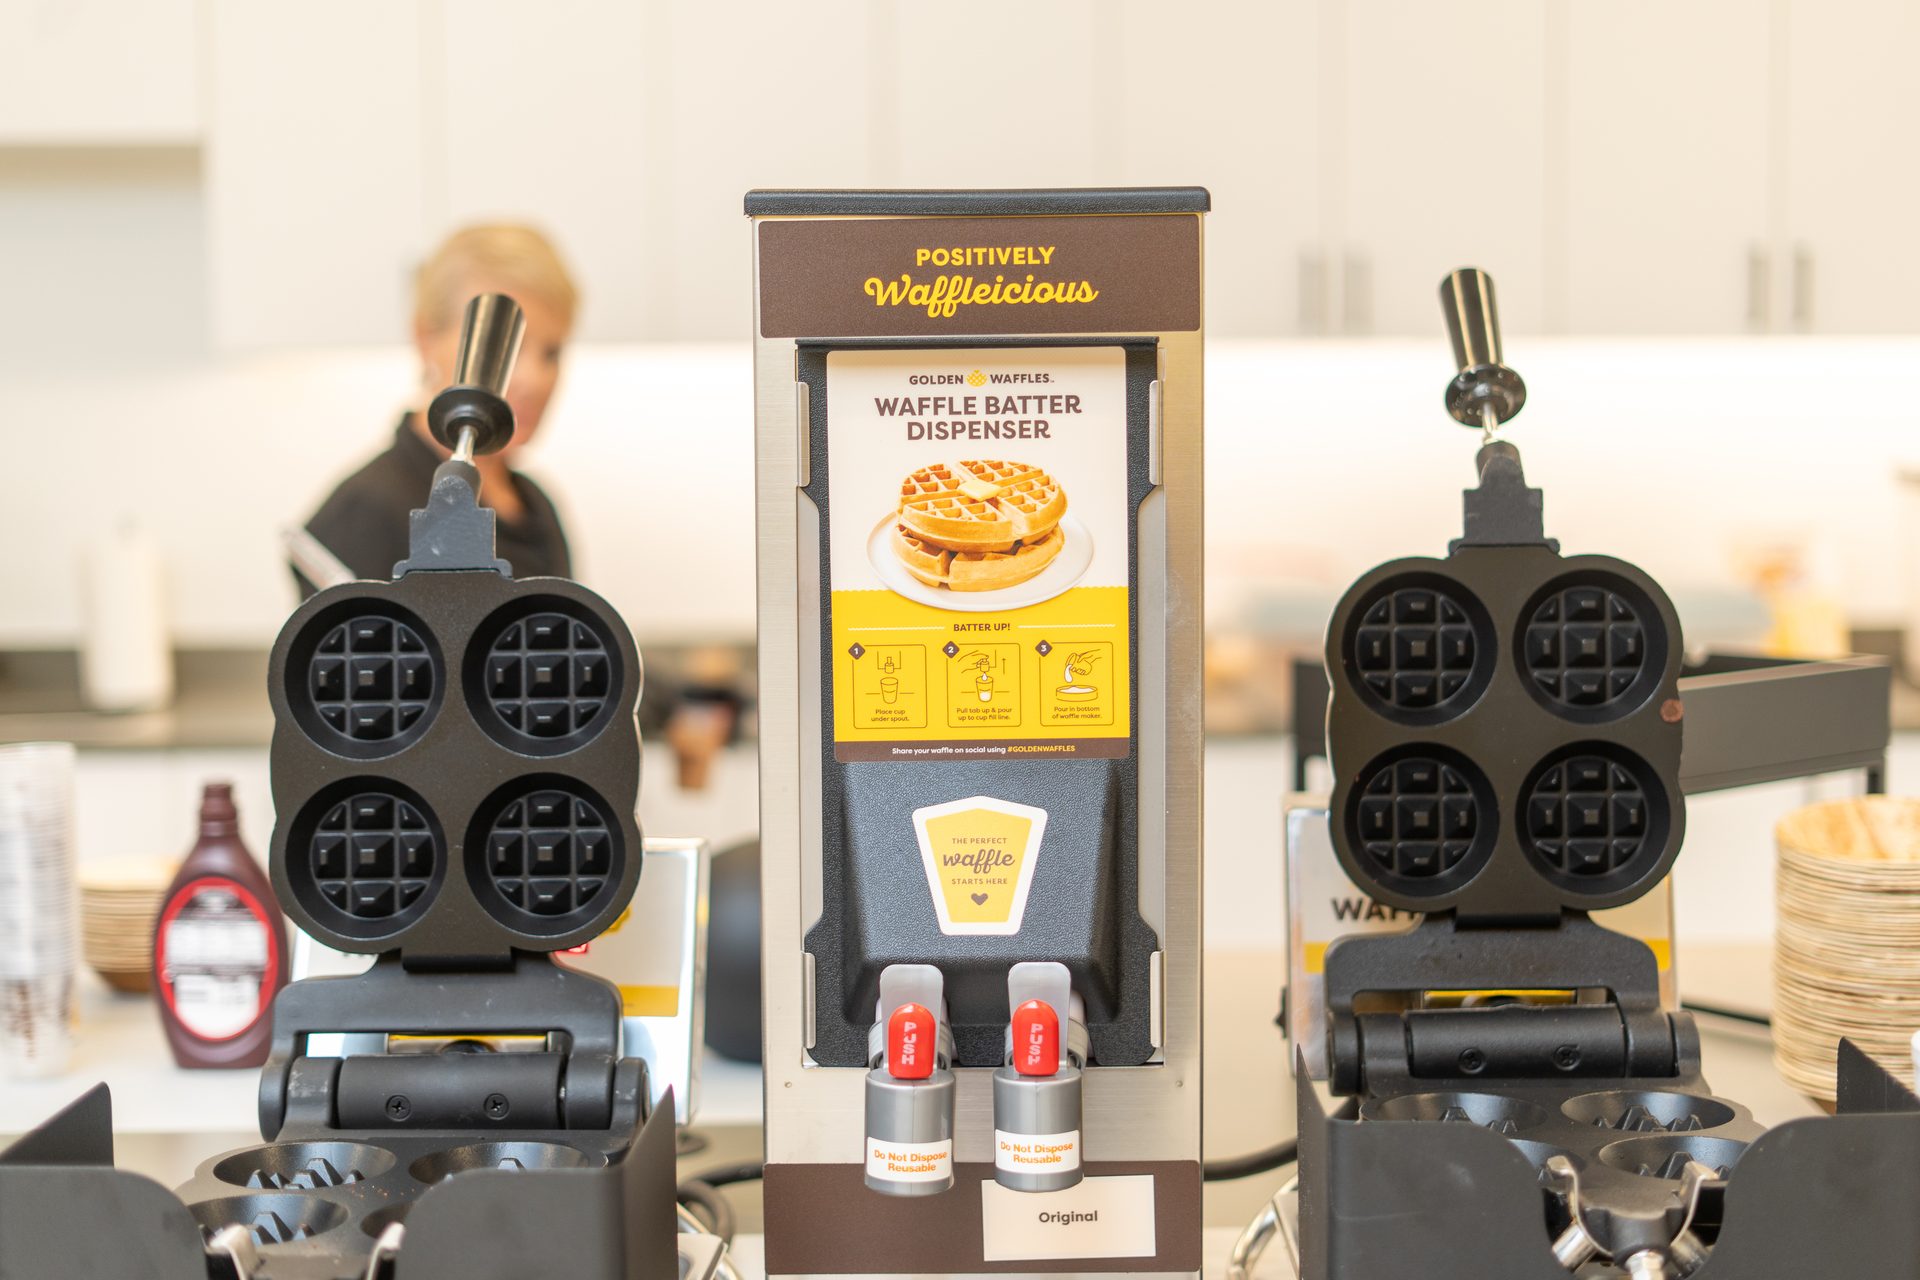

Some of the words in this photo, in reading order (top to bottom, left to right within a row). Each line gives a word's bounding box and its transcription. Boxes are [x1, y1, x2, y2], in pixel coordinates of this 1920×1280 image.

[916, 246, 1055, 266] POSITIVELY
[864, 274, 1099, 318] Waffleicious
[909, 375, 964, 385] GOLDEN
[874, 396, 977, 416] WAFFLE
[985, 395, 1082, 415] BATTER
[907, 420, 1051, 440] DISPENSER
[953, 624, 991, 632] BATTER
[994, 623, 1011, 632] UP!
[931, 747, 953, 755] waffle
[987, 747, 1006, 755] using
[1007, 745, 1076, 753] #GOLDENWAFFLES
[943, 849, 1015, 874] waffle
[902, 1022, 917, 1065] PUSH
[1028, 1023, 1043, 1065] PUSH
[1000, 1141, 1011, 1151] Do
[1013, 1143, 1031, 1153] Not
[1034, 1142, 1073, 1154] Dispose
[874, 1150, 886, 1160] Do
[888, 1152, 908, 1161] Not
[910, 1151, 947, 1163] Dispose
[1013, 1153, 1061, 1163] Reusable
[888, 1162, 936, 1172] Reusable
[1039, 1210, 1098, 1225] Original
